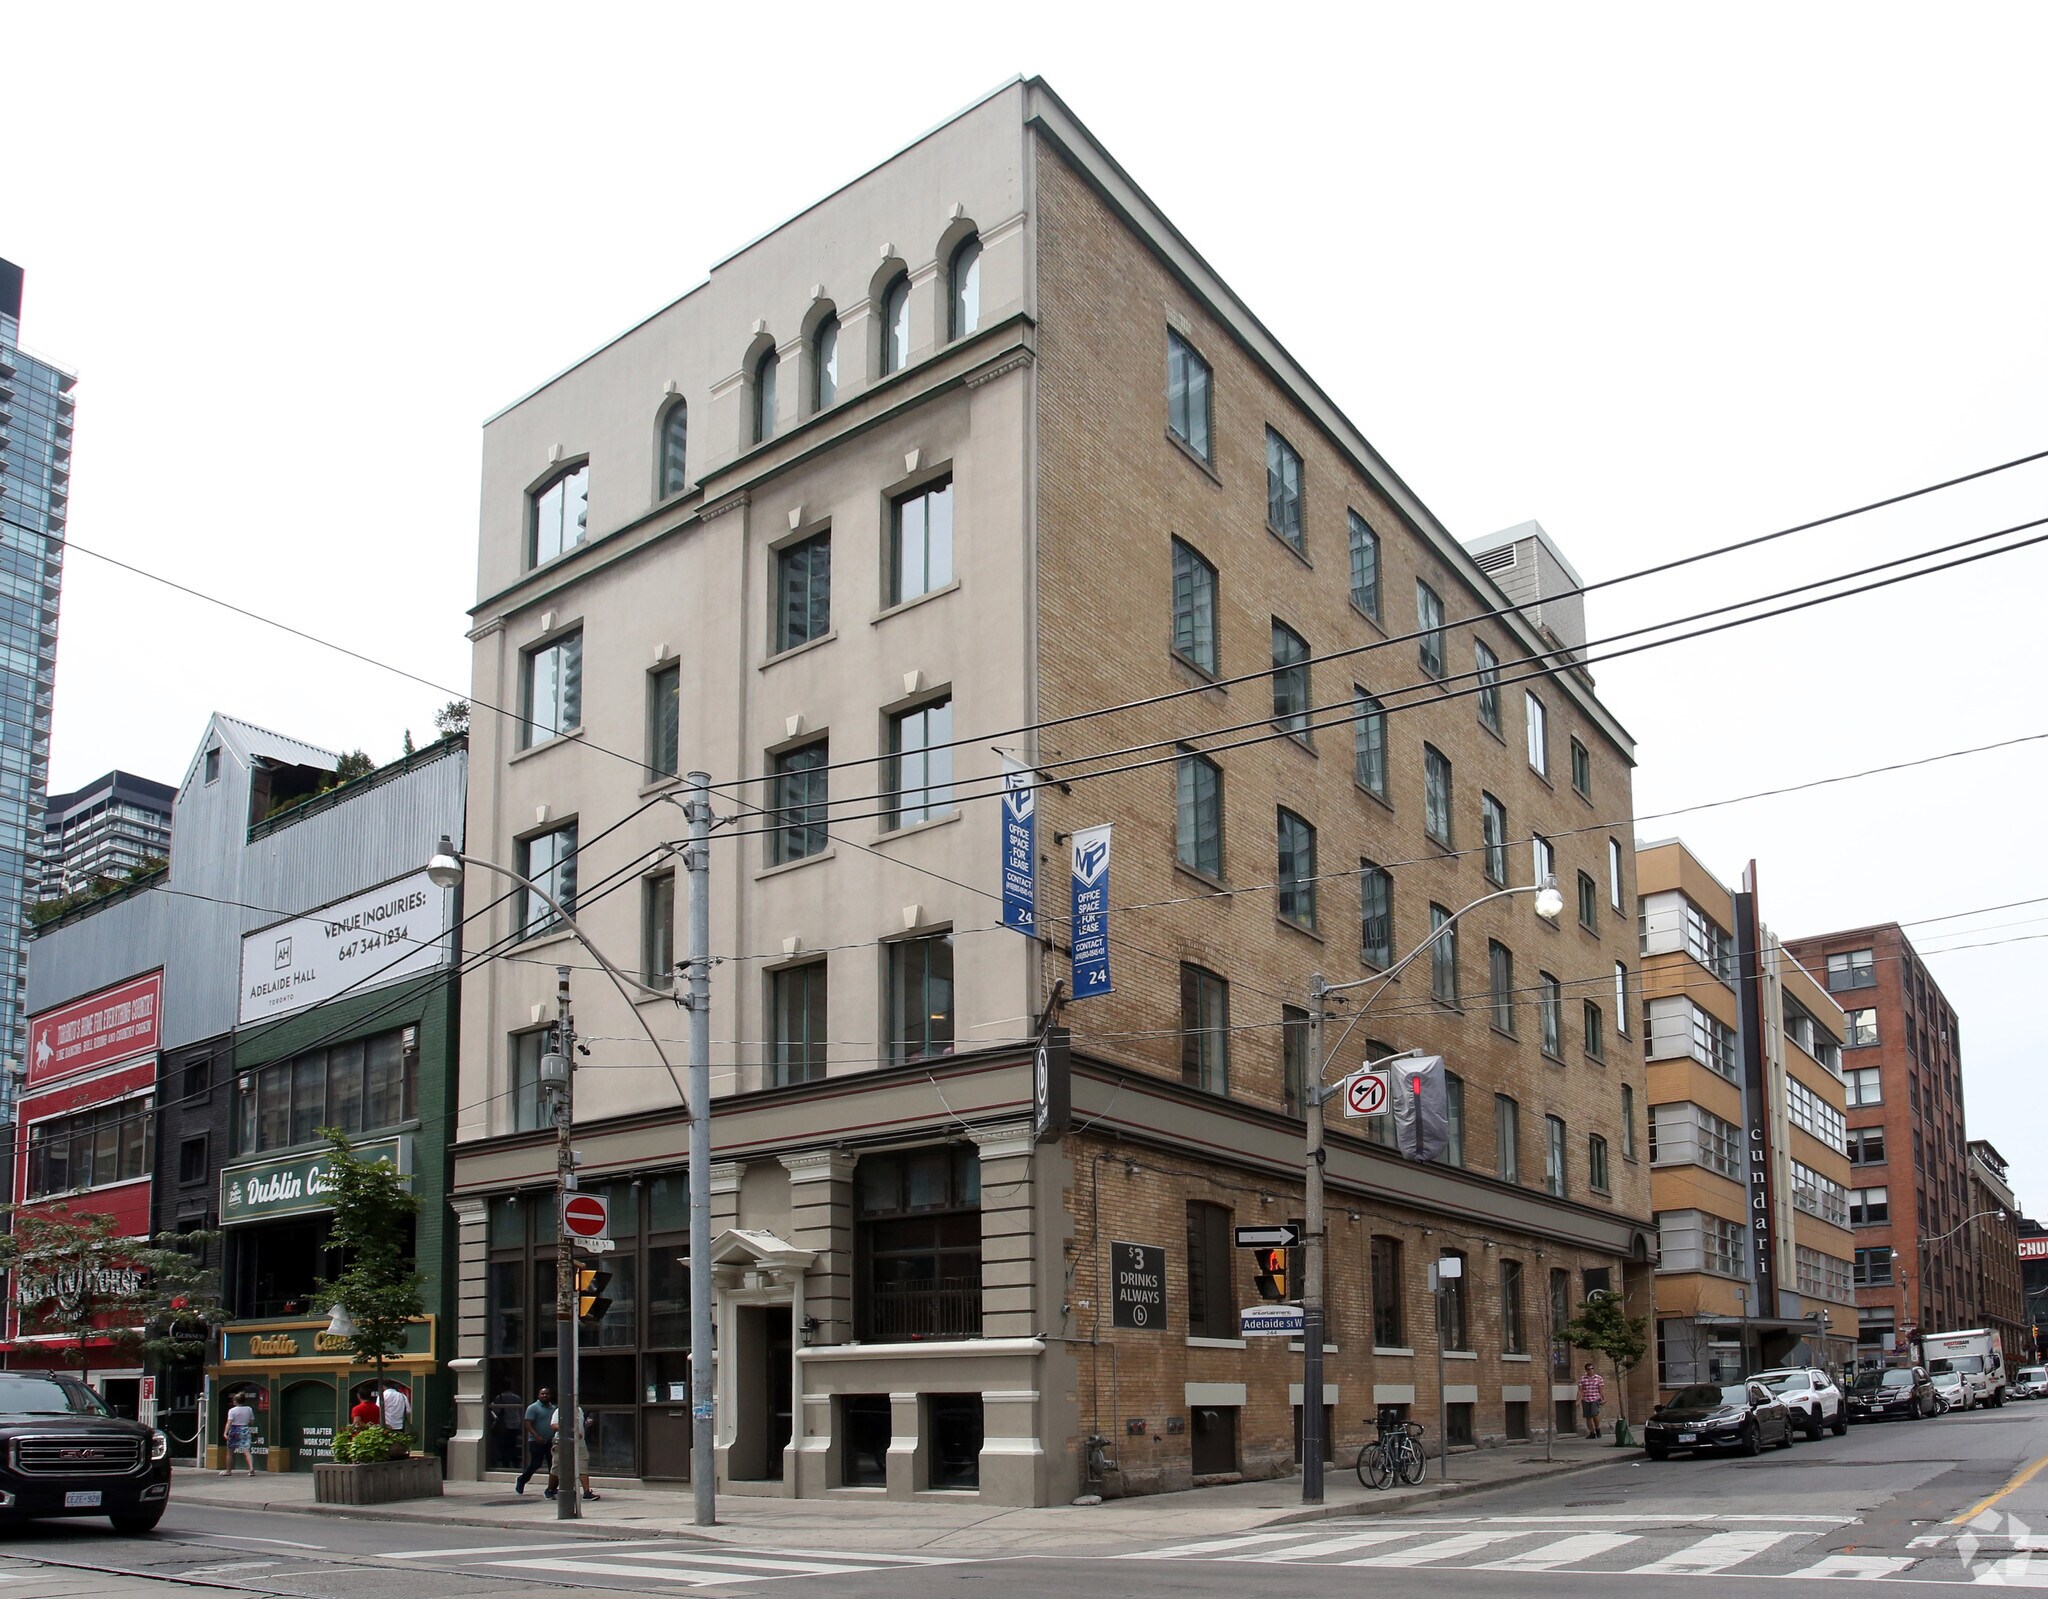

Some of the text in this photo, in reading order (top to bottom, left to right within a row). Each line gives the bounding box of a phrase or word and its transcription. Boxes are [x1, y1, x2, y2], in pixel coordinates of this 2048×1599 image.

[1008, 823, 1030, 840] OFFICE
[1009, 834, 1030, 851] SPACE
[1013, 847, 1026, 860] FOR
[1010, 856, 1029, 872] LEASE
[1007, 872, 1031, 889] CONTACT
[1078, 889, 1100, 903] OFFICE
[324, 891, 427, 938] VENUE INQUIRIES:
[1078, 900, 1100, 914] SPACE
[1018, 908, 1032, 922] 24
[1081, 914, 1096, 924] FOR
[1078, 922, 1099, 935] LEASE
[338, 925, 408, 961] 647 344 1234
[1075, 938, 1103, 952] CONTACT
[277, 946, 289, 961] AH
[250, 969, 316, 998] ADELAIDE HALL
[1089, 969, 1106, 985] 24
[269, 994, 294, 1006] TORONTO
[248, 1172, 301, 1205] Dublin
[1751, 1128, 1768, 1274] cundari
[1129, 1246, 1145, 1270] $3
[1120, 1271, 1158, 1288] DRINKS
[1120, 1288, 1160, 1304] ALWAYS
[1244, 1318, 1303, 1329] Adelaide St W
[250, 1334, 298, 1355] Dublin
[303, 1427, 332, 1436] YOUR AFTER
[303, 1438, 318, 1446] WORK
[60, 1449, 104, 1459] GMC
[299, 1448, 312, 1457] FOOD
